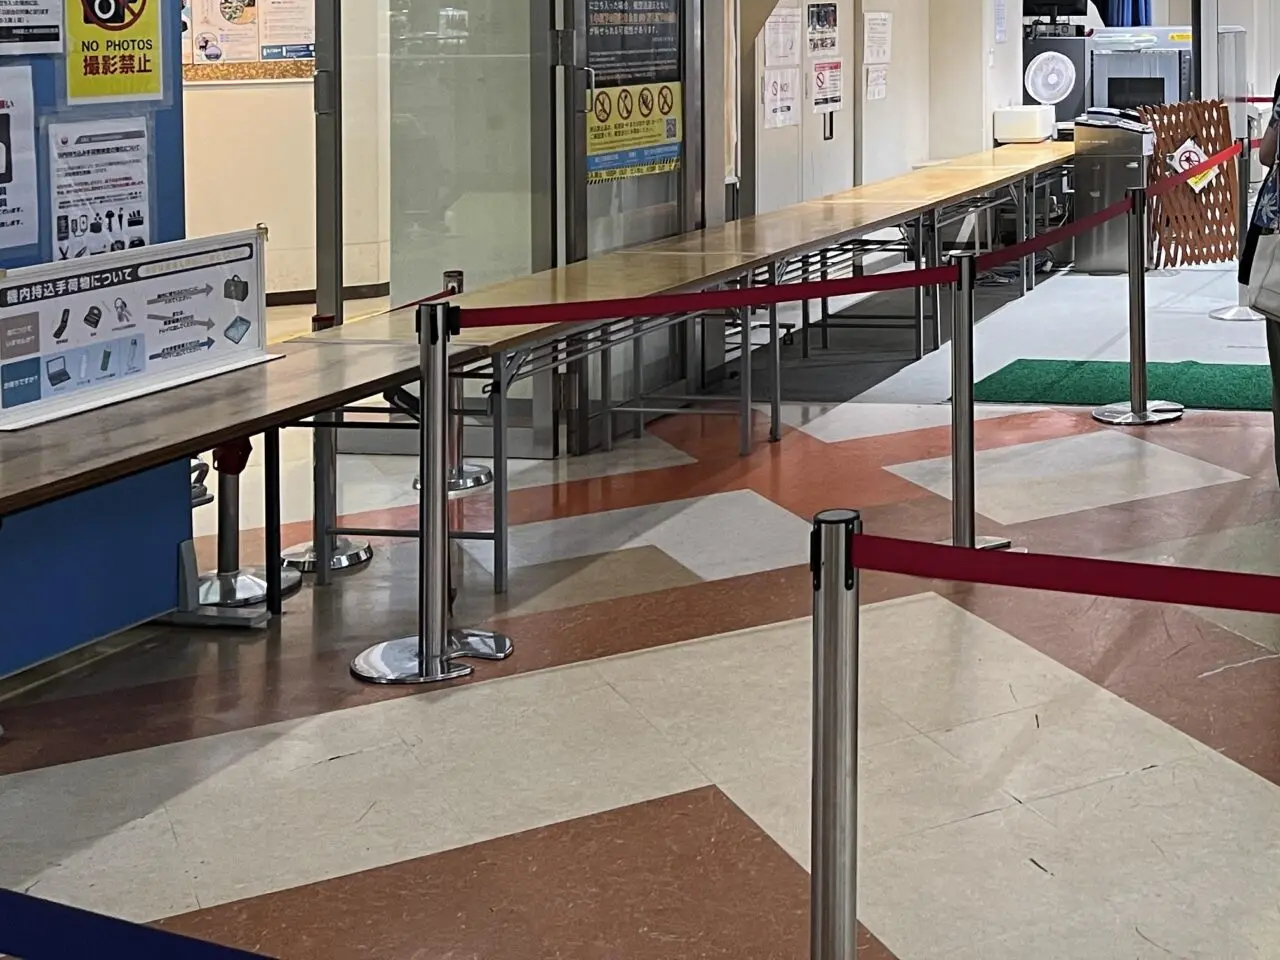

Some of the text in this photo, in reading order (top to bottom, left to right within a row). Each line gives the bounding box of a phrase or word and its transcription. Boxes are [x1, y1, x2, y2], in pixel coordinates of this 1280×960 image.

[82, 39, 153, 52] NO PHOTOS
[83, 54, 152, 76] 撮影禁止
[6, 267, 133, 305] 機内持込手荷物について
